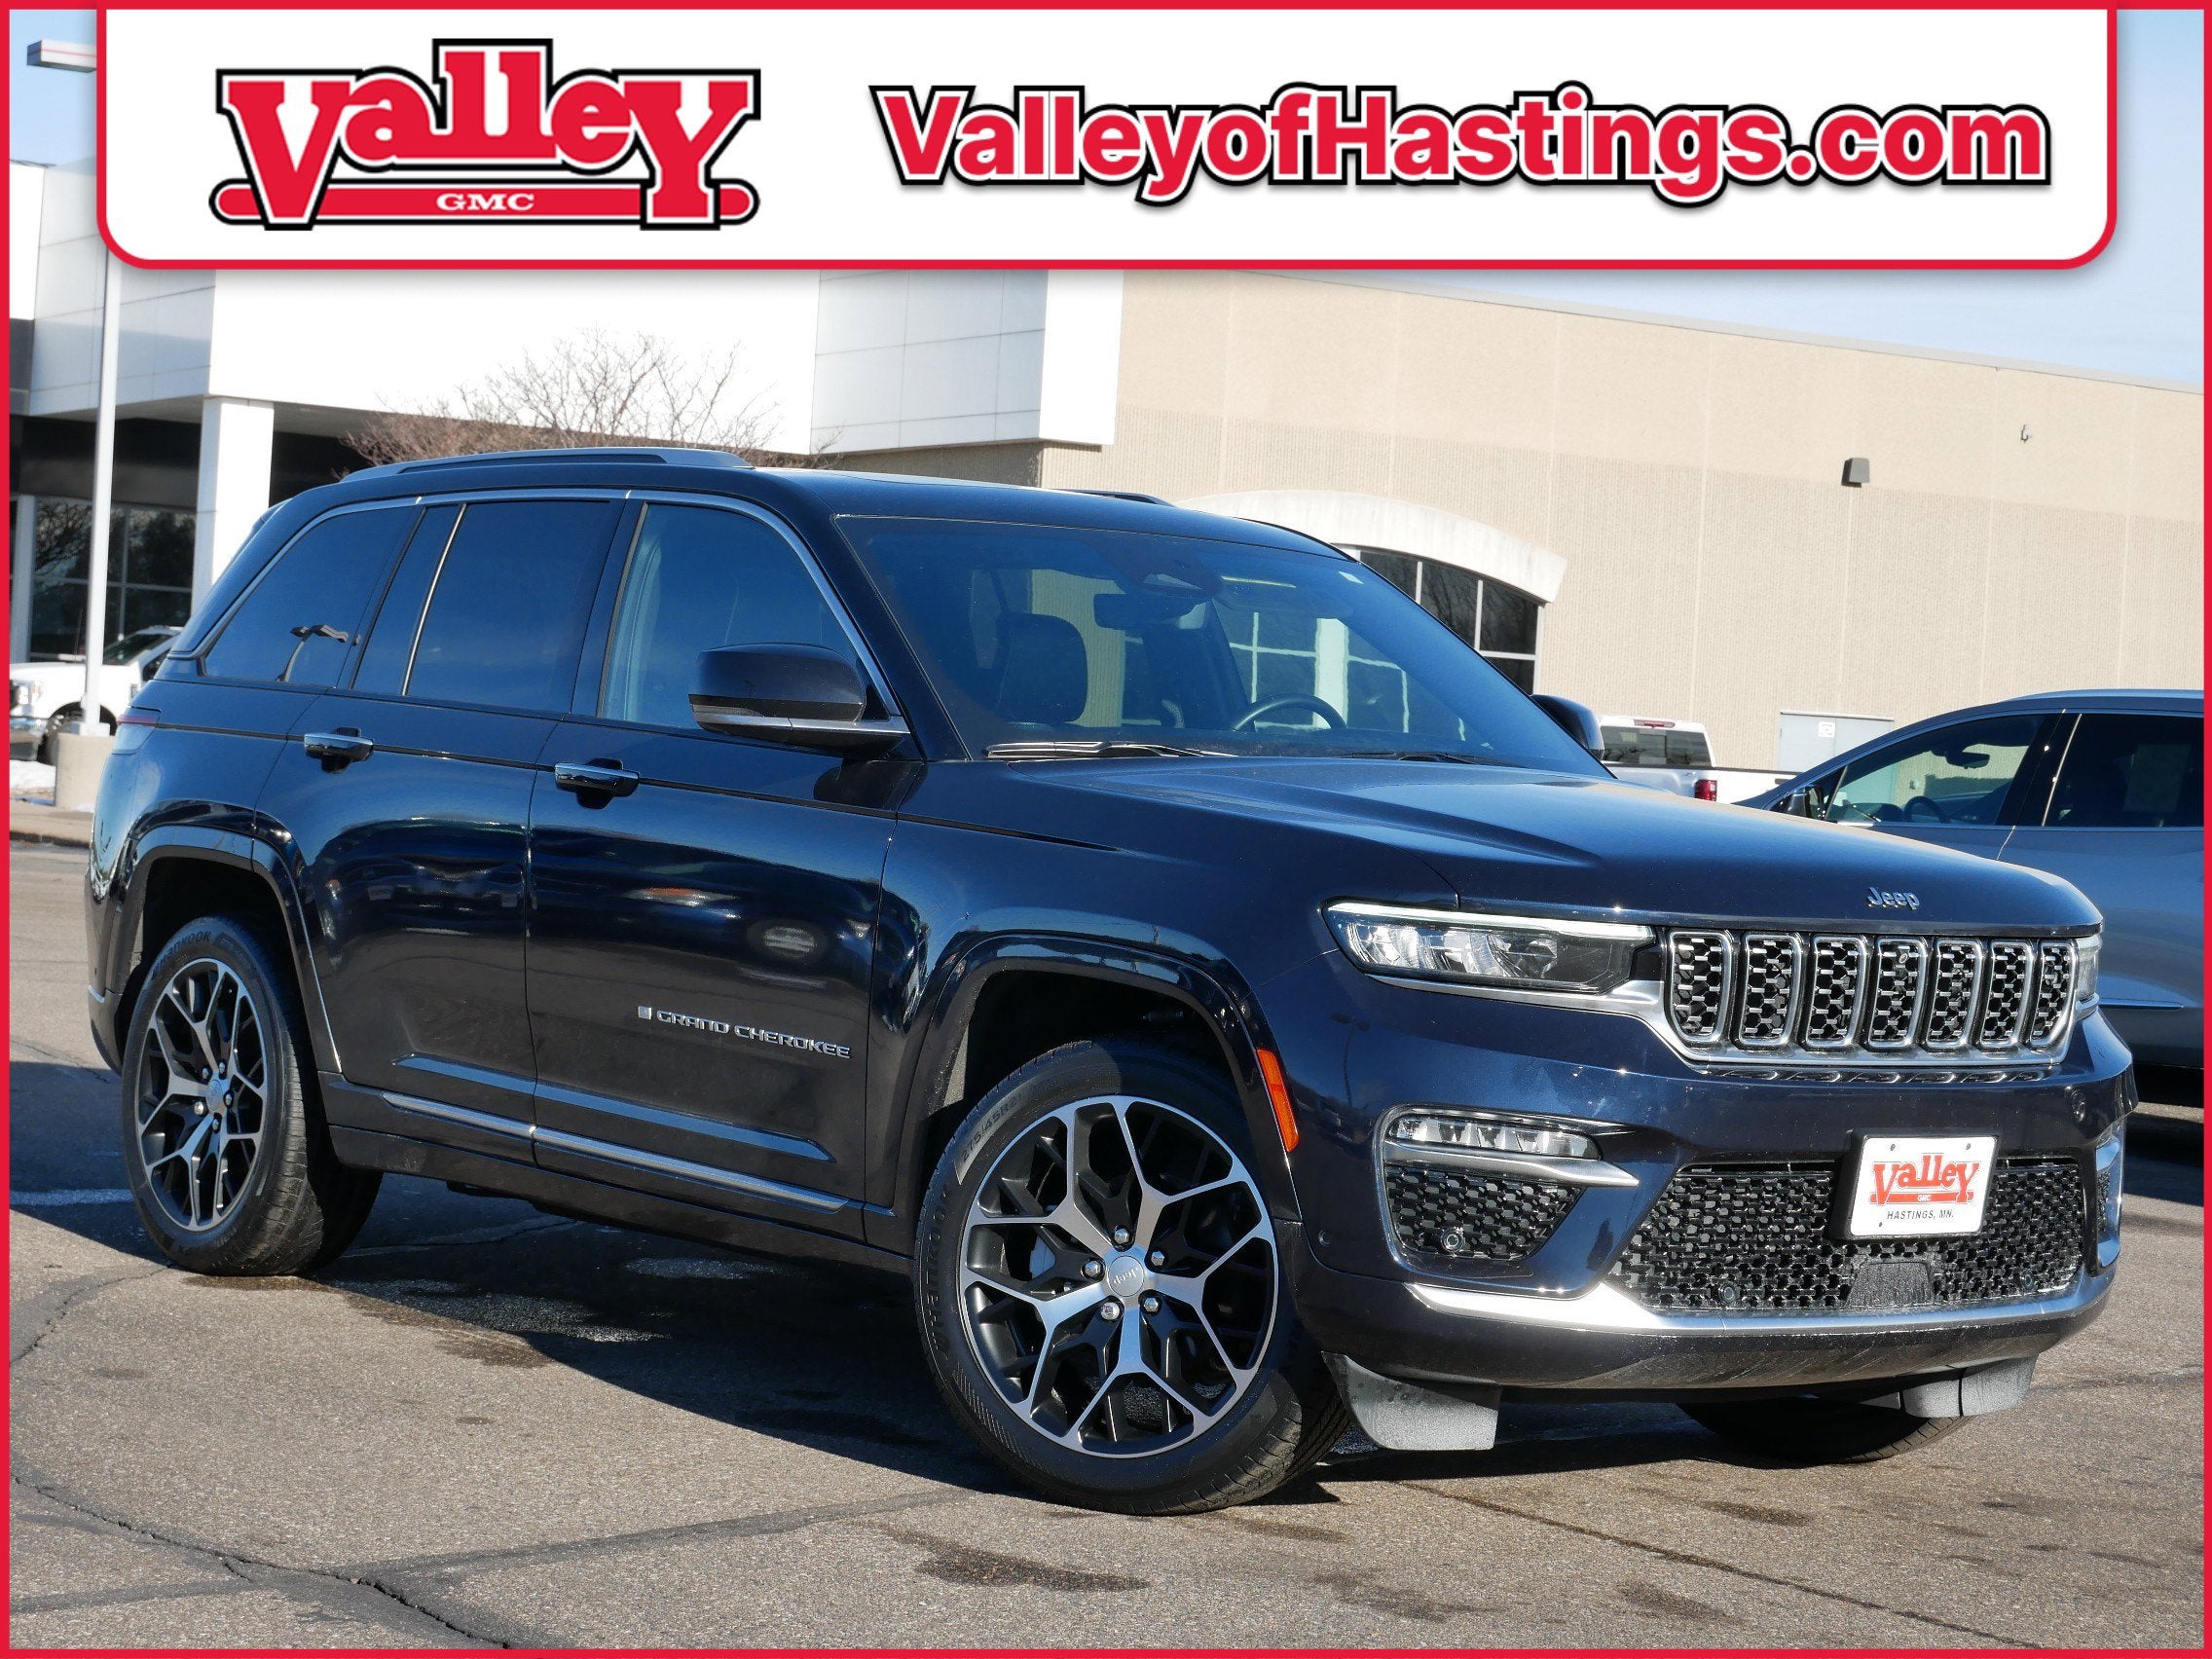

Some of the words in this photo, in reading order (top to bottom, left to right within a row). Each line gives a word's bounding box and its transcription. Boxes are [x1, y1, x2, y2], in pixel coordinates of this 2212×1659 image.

[1866, 886, 1920, 910] Jeep
[656, 1009, 730, 1035] GRAND
[733, 1024, 851, 1059] CHEROKEE
[1871, 1153, 1980, 1206] Valley
[1916, 1194, 1932, 1202] GMC
